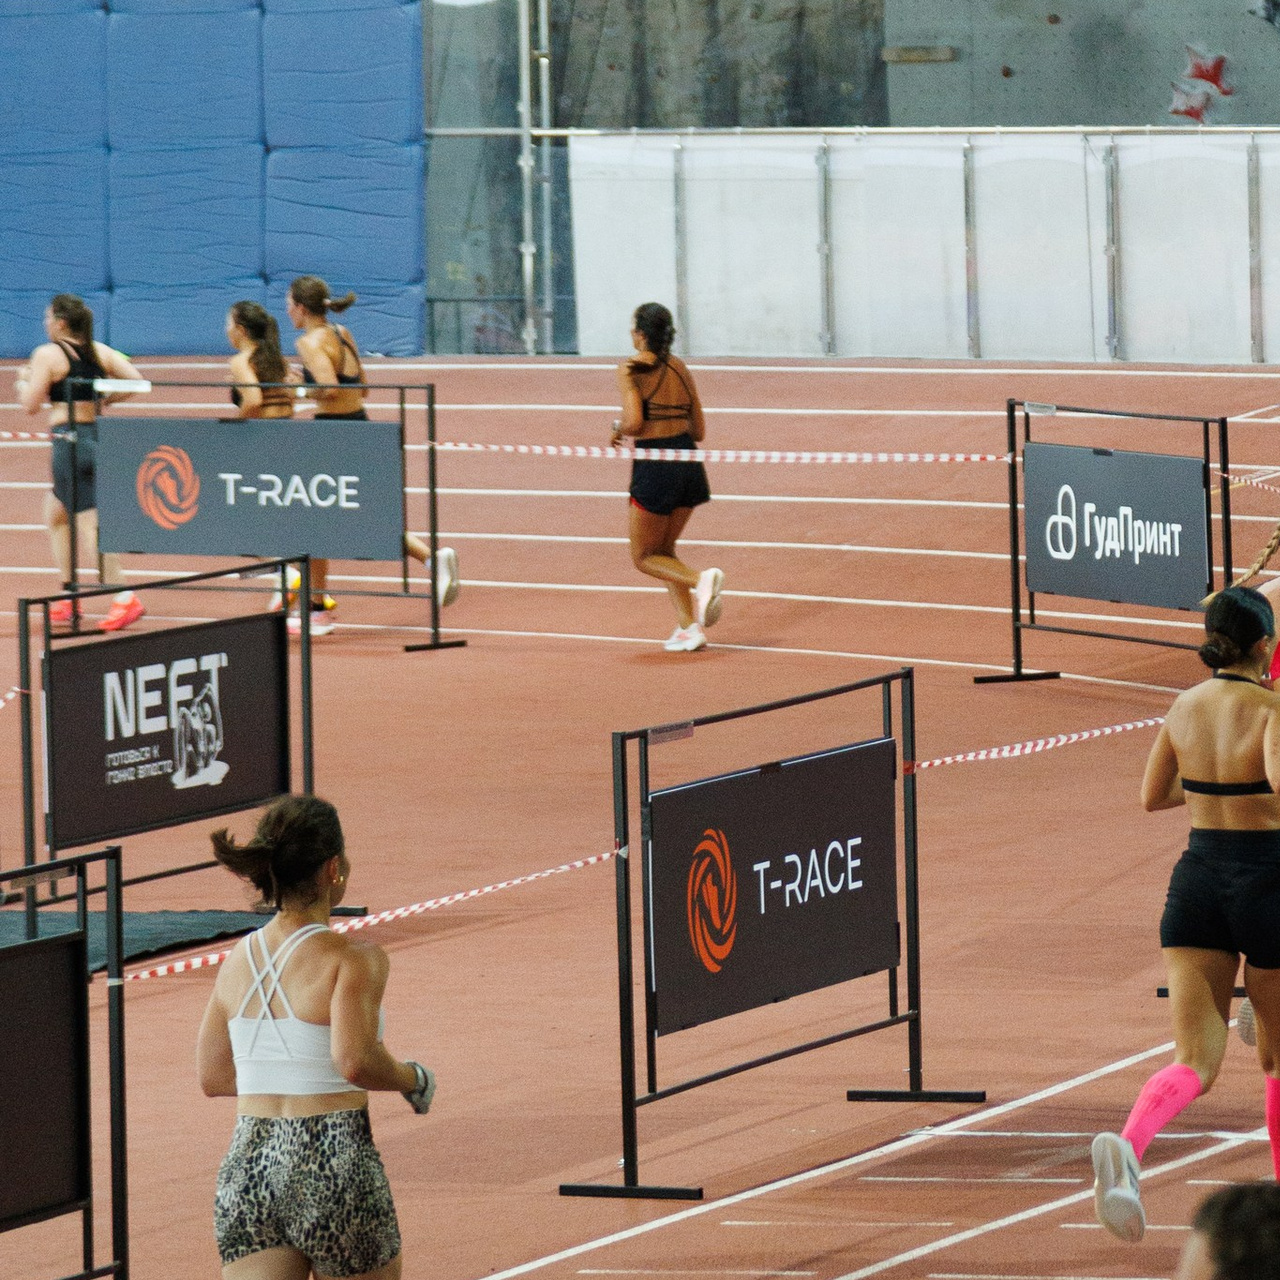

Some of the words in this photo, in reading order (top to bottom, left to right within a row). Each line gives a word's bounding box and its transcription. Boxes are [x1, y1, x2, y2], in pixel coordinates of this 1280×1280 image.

[218, 473, 360, 508] T-RACE
[1084, 503, 1182, 565] ГудПринт
[103, 652, 229, 741] NEFT
[753, 837, 863, 914] T-RACE
